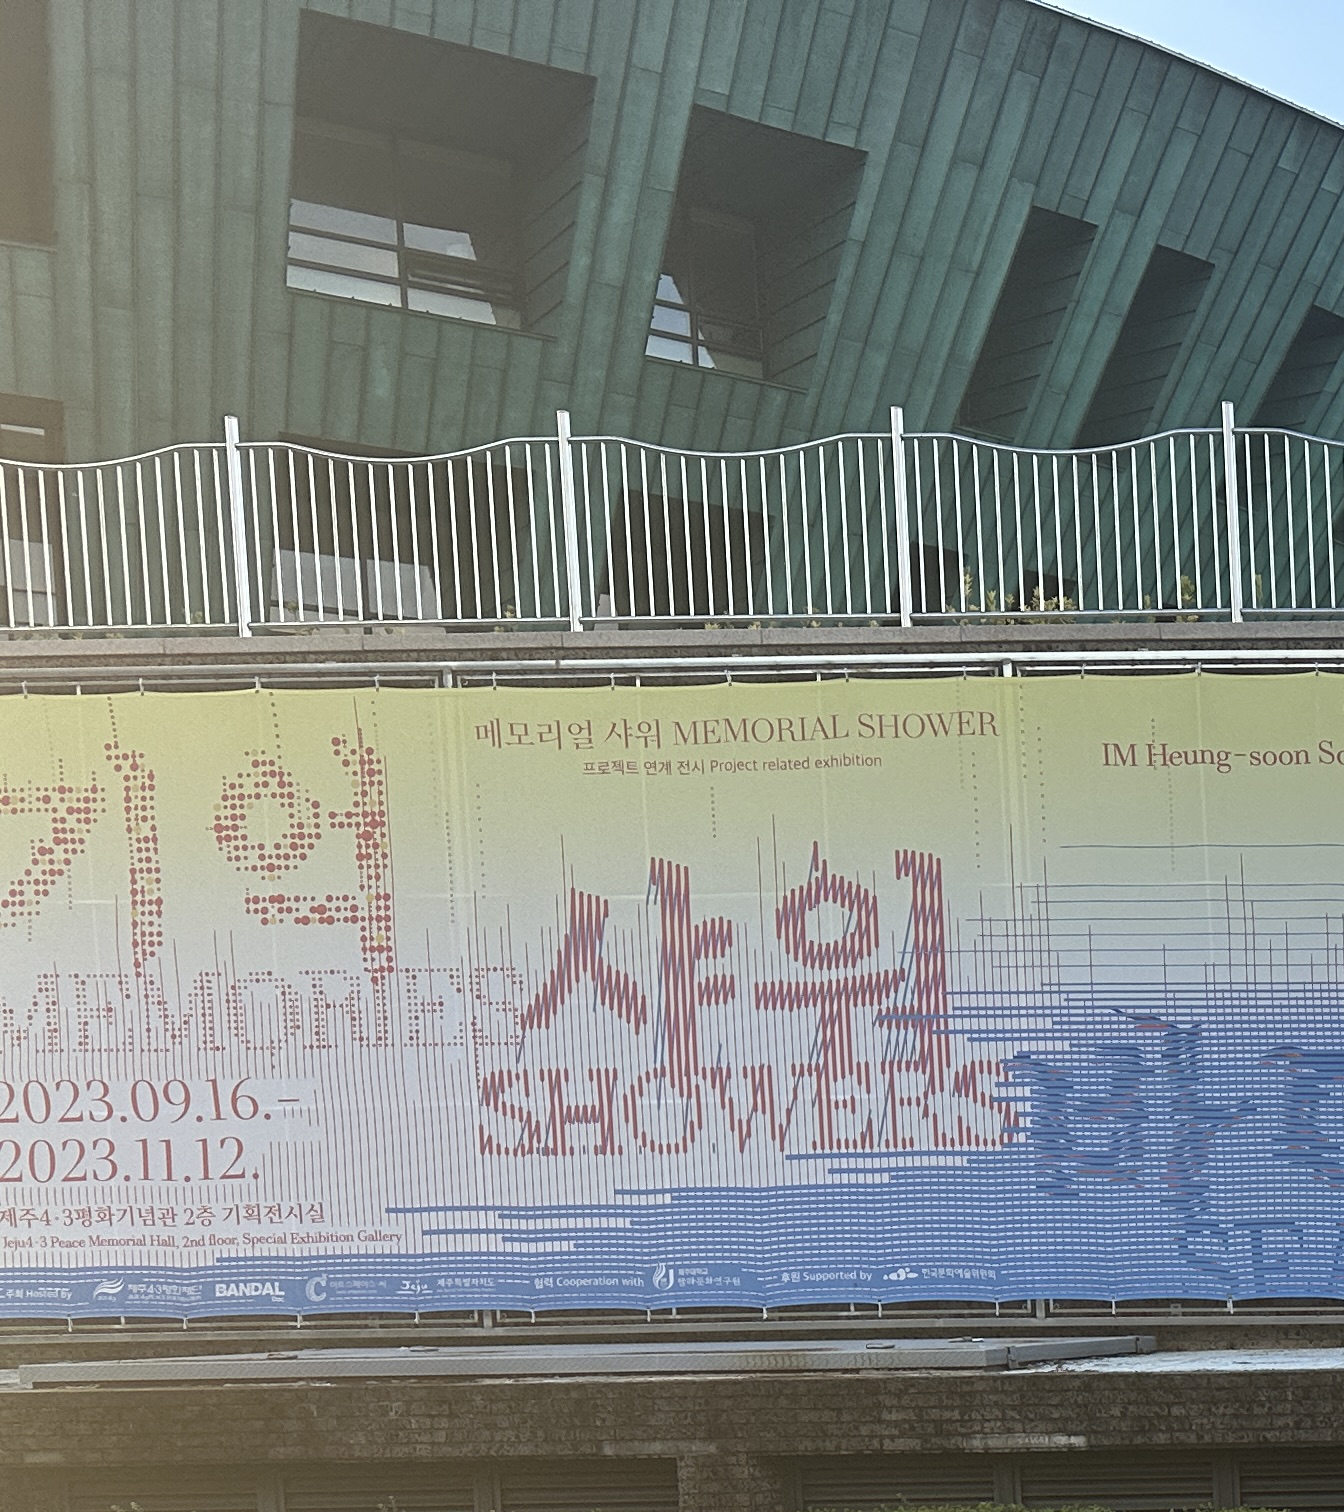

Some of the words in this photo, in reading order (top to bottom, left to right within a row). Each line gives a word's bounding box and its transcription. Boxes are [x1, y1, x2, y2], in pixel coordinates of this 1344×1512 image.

[474, 717, 594, 751] 메모리얼
[604, 717, 662, 749] 샤워
[672, 713, 850, 747] MEMORIAL
[856, 709, 1000, 739] SHOWER
[582, 760, 639, 776] 프로젝트
[643, 760, 672, 776] 연계
[676, 759, 705, 775] 전시
[710, 759, 758, 774] Project
[762, 757, 810, 772] related
[814, 754, 882, 769] exhibition
[1102, 742, 1138, 767] IM
[1146, 741, 1311, 774] Heung-soon
[0, 732, 396, 986] 기억
[515, 840, 948, 1100] 샤워
[478, 1062, 1026, 1158] SHOWERS
[0, 1136, 260, 1184] 2023.11.12.
[183, 1204, 216, 1228] 2층
[222, 1201, 326, 1226] 기획전시실
[50, 1235, 86, 1249] Peace
[88, 1234, 147, 1248] Memorial
[149, 1234, 180, 1250] Hall,
[182, 1234, 206, 1249] 2nd
[208, 1233, 239, 1248] floor,
[242, 1231, 287, 1247] Special
[290, 1230, 354, 1245] Exhibition
[357, 1229, 402, 1245] Gallery
[400, 1279, 428, 1294] Jeju
[556, 1276, 619, 1288] Cooperation
[621, 1275, 645, 1288] with
[780, 1271, 800, 1284] 후원
[802, 1270, 857, 1283] Supported
[859, 1269, 872, 1282] by
[25, 1287, 60, 1299] Hosted
[61, 1287, 73, 1301] by
[214, 1281, 286, 1298] BANDAL
